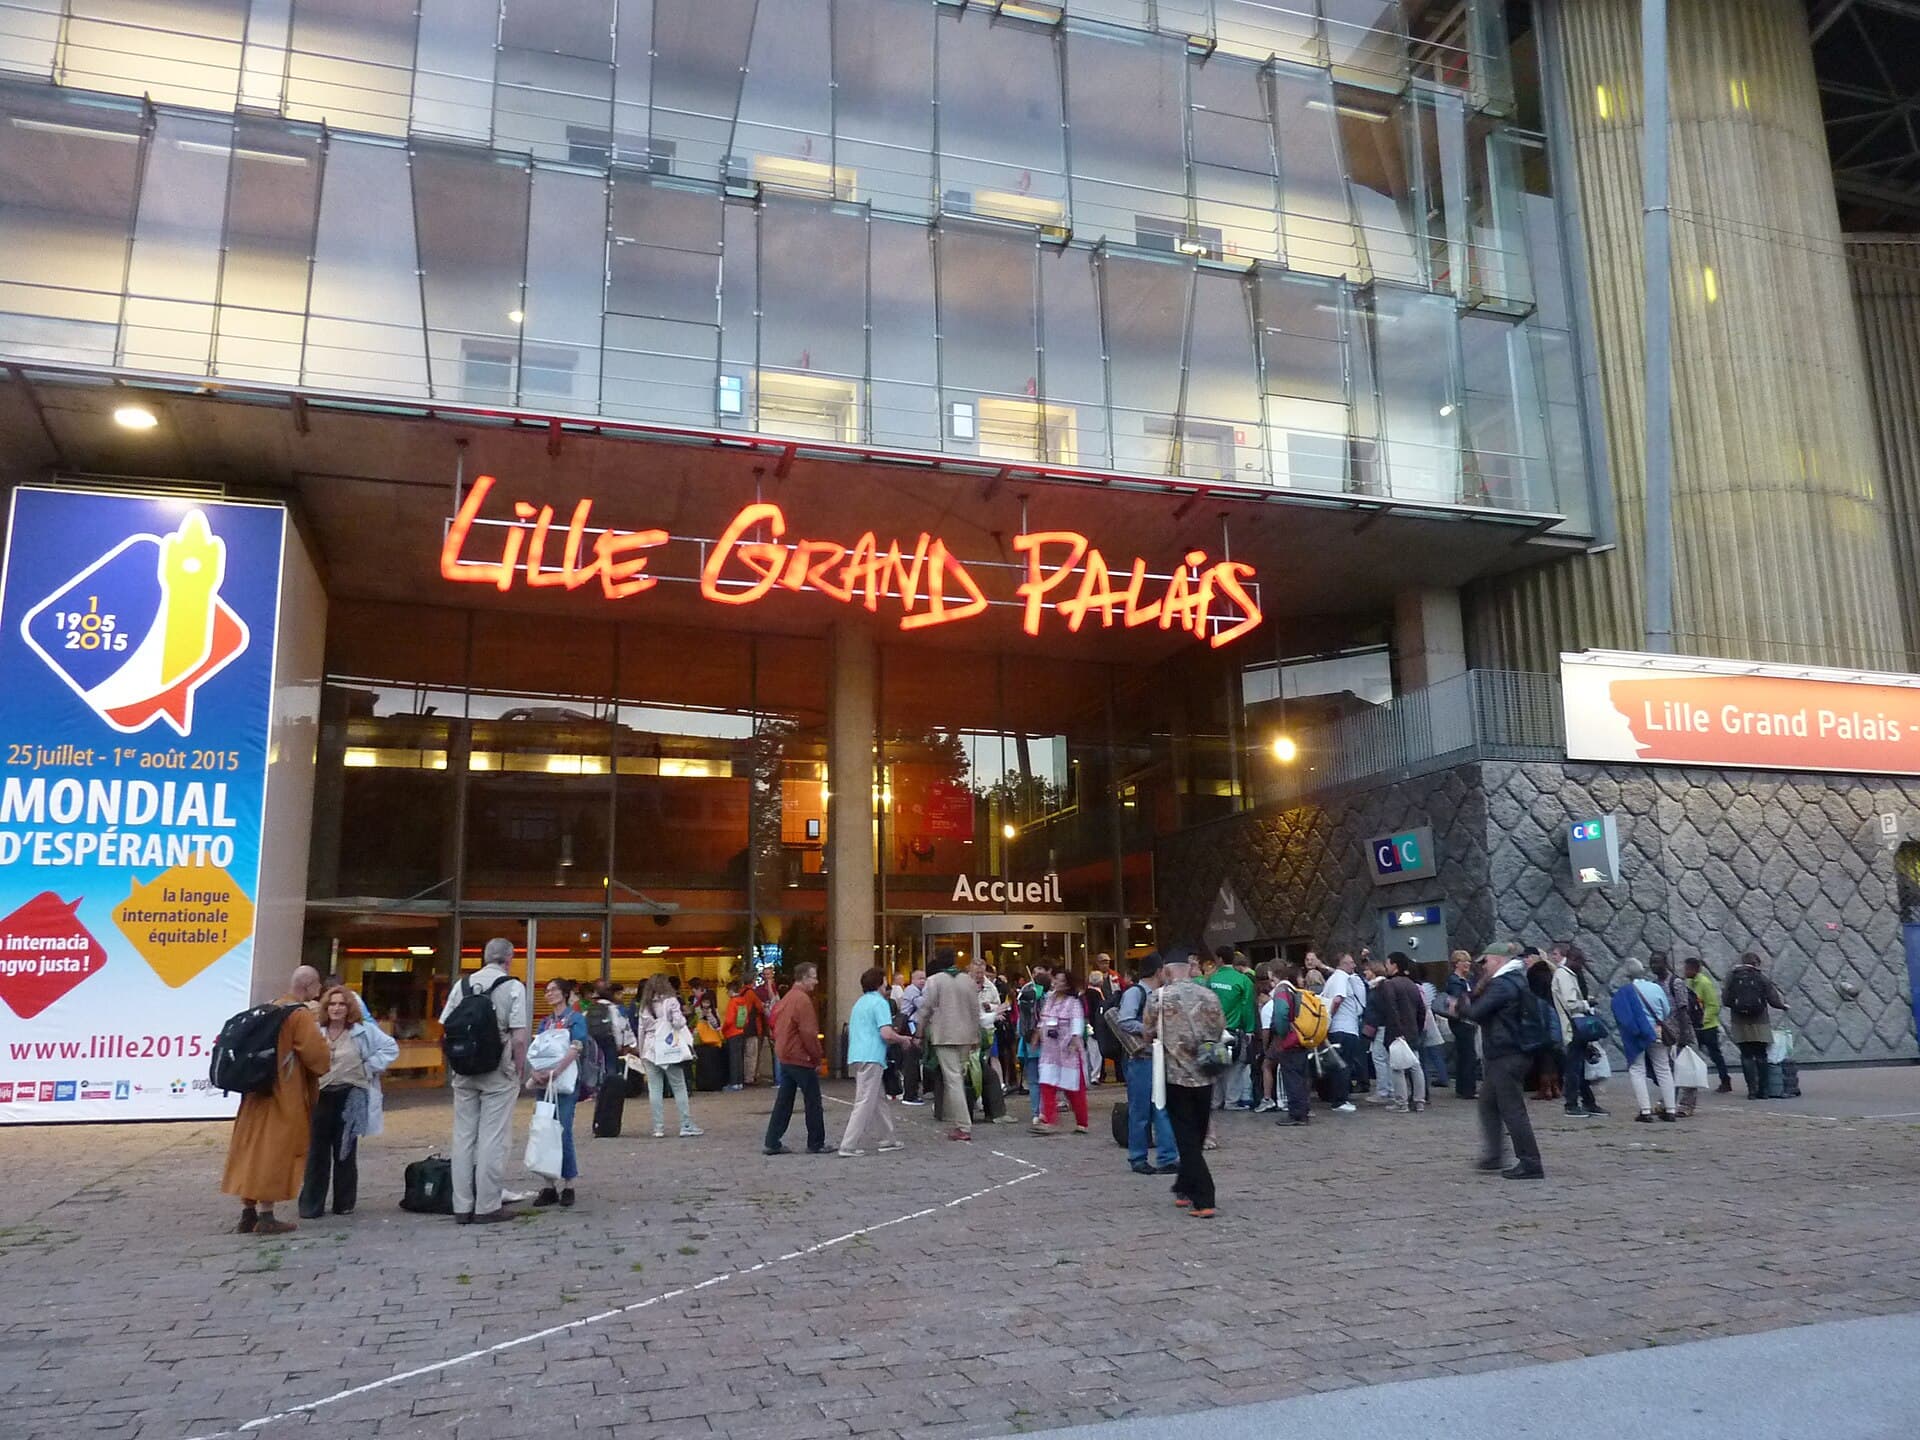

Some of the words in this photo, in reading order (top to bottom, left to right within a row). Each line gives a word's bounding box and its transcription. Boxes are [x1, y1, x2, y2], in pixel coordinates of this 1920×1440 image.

[55, 612, 116, 632] 1905
[65, 631, 128, 652] 2015
[1644, 700, 1711, 733] Lille
[1721, 704, 1807, 738] Grand
[1818, 710, 1902, 742] Palais
[7, 745, 33, 766] 25
[34, 745, 94, 770] juillet
[140, 748, 187, 769] août
[191, 750, 239, 771] 2015
[0, 777, 237, 828] MONDIAL
[1573, 823, 1599, 839] CIC
[1378, 841, 1416, 868] CIC
[163, 888, 177, 903] la
[180, 888, 230, 907] langue
[951, 873, 1063, 903] Accueil
[122, 907, 229, 923] internationale
[6, 933, 89, 951] internacia
[149, 928, 219, 946] équitable
[37, 955, 81, 977] justa
